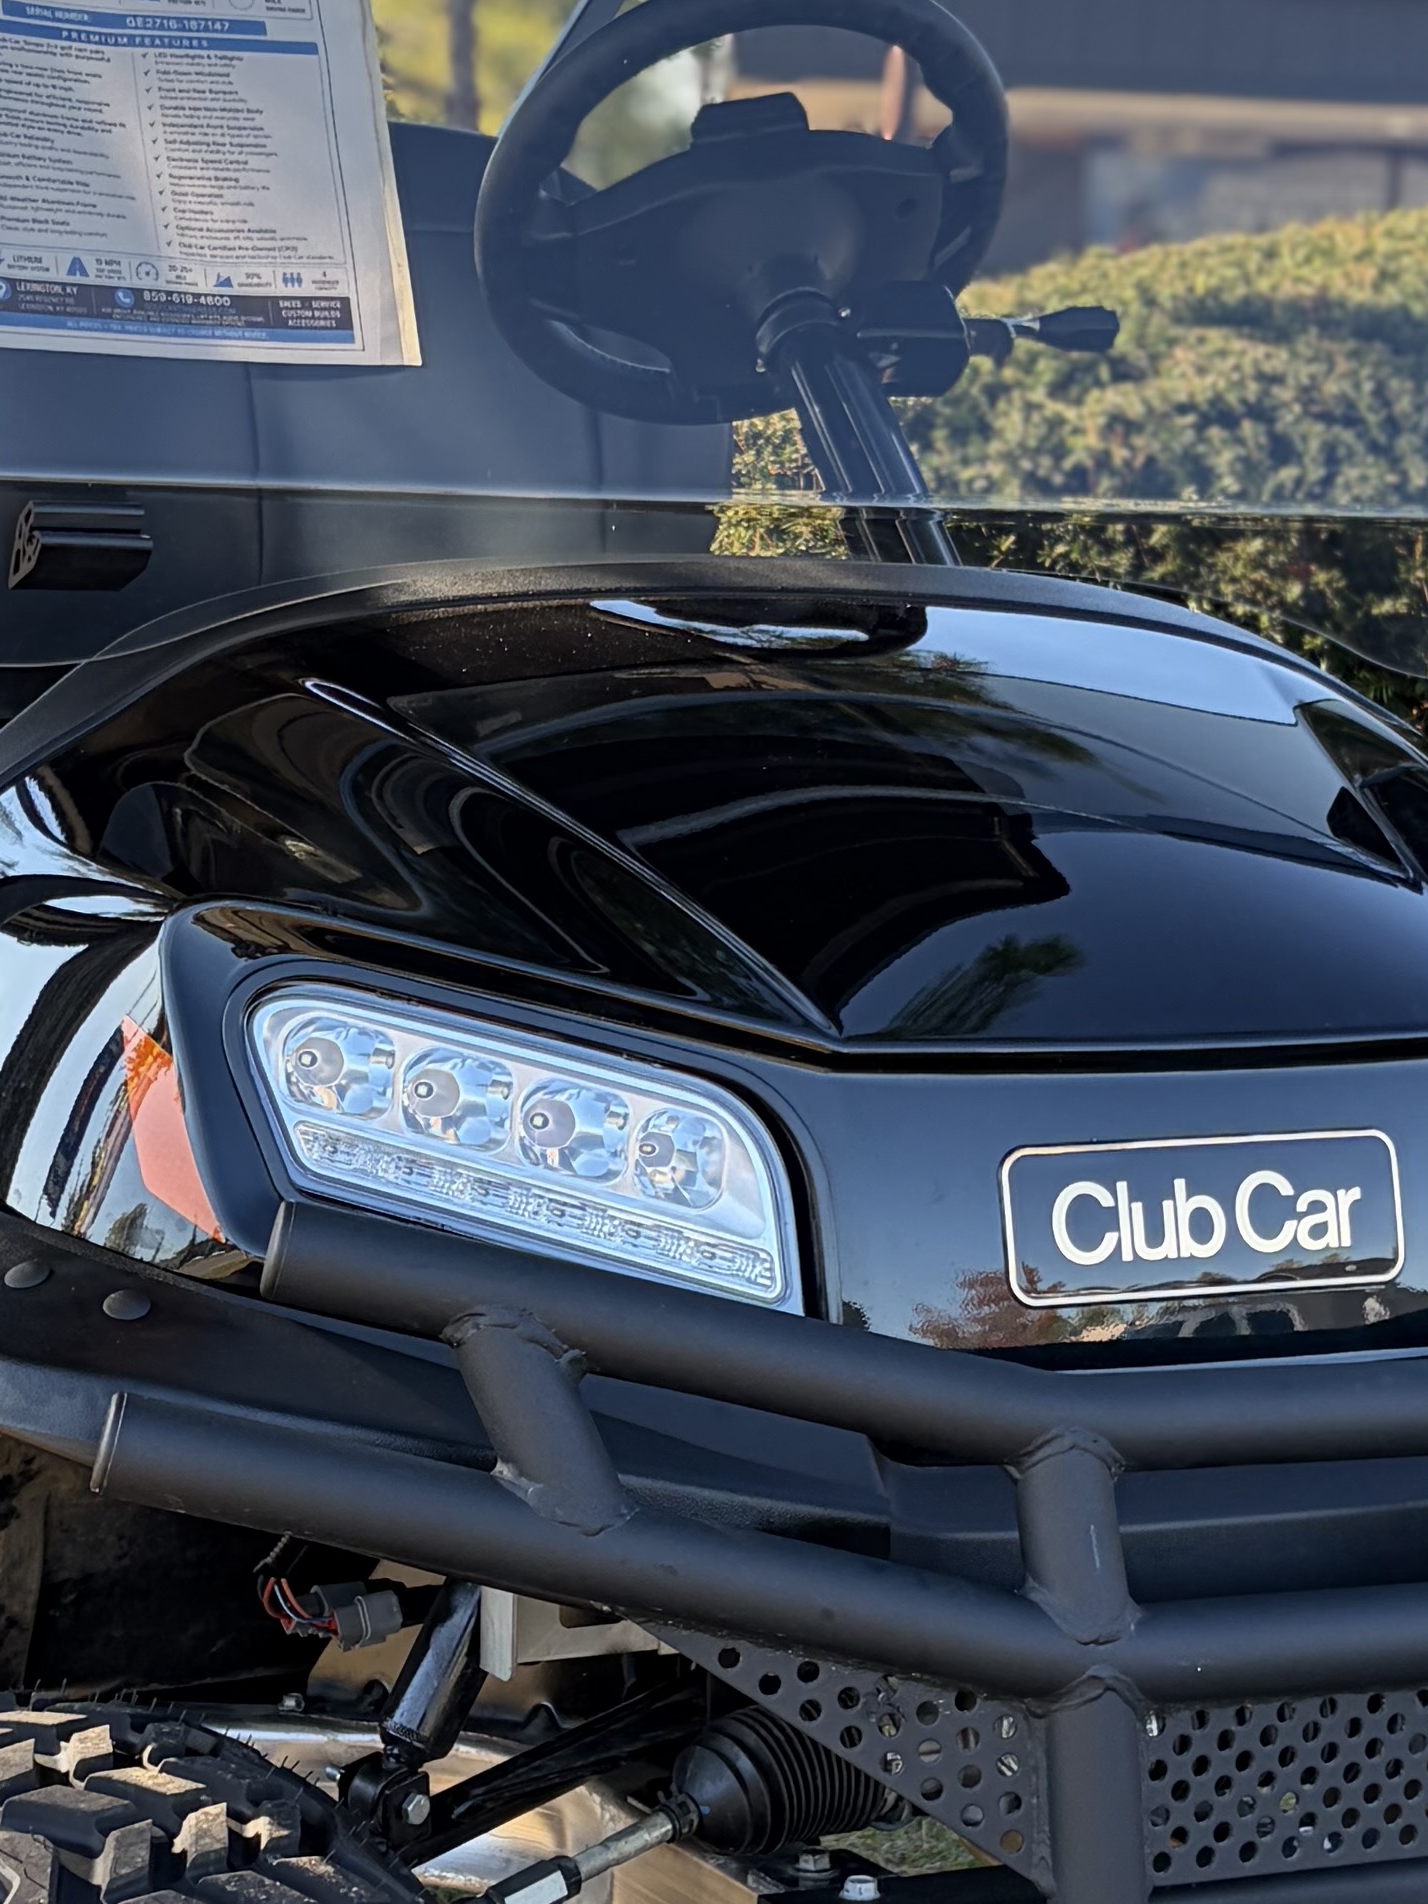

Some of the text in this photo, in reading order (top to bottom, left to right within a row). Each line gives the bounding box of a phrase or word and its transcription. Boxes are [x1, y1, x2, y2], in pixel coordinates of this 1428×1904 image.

[61, 30, 128, 45] PREMIUM
[135, 37, 208, 48] FEATURES
[66, 286, 79, 296] KY
[1052, 1170, 1361, 1265] Club Car
